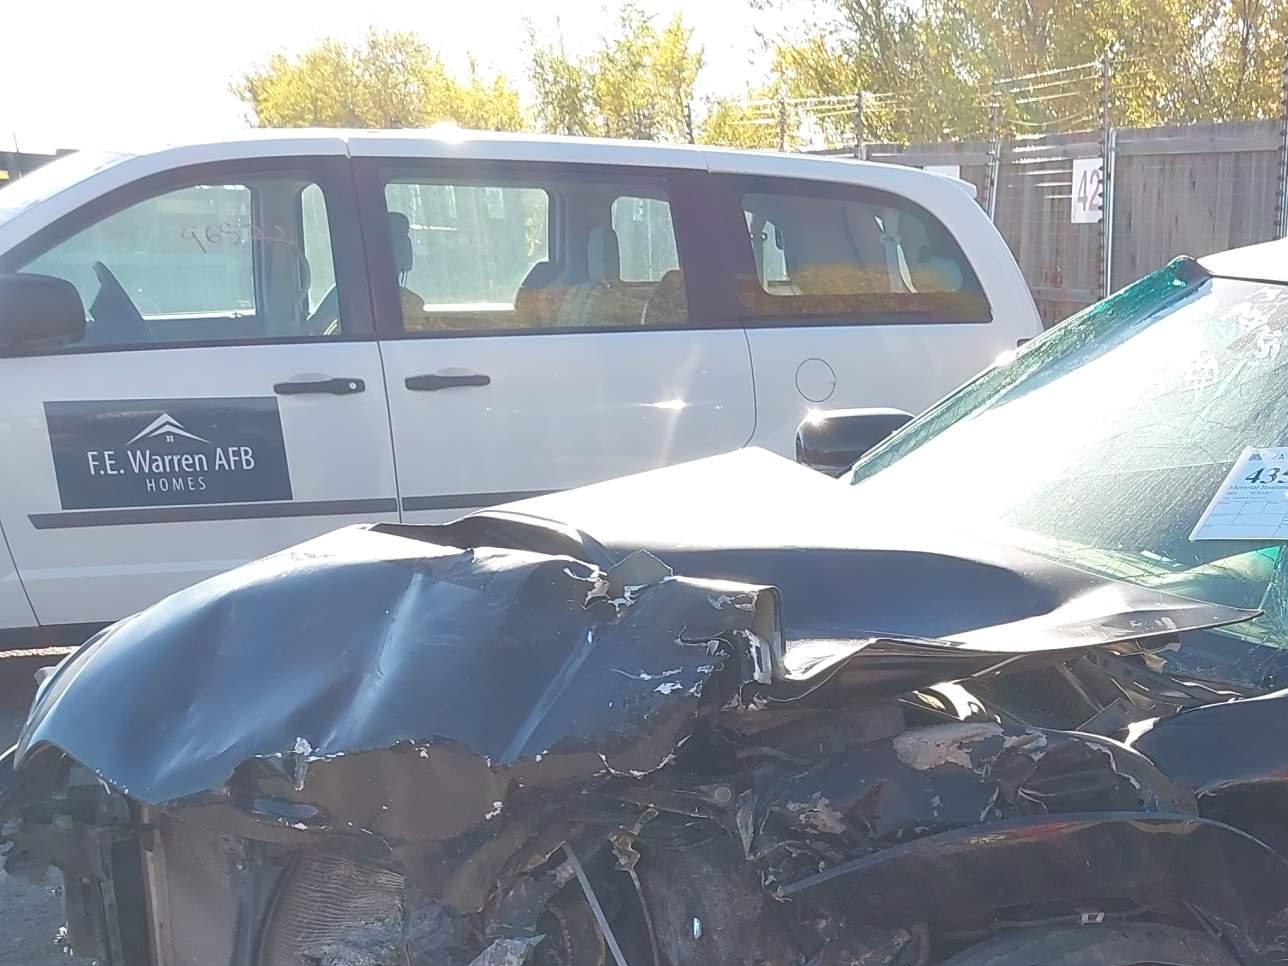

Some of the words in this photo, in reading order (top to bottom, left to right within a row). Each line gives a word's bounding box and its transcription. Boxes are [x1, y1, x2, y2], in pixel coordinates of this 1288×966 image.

[1078, 169, 1100, 213] 42
[87, 451, 125, 475] F.E.
[127, 449, 208, 473] Warren
[215, 446, 255, 470] AFB
[146, 476, 207, 492] HOMES
